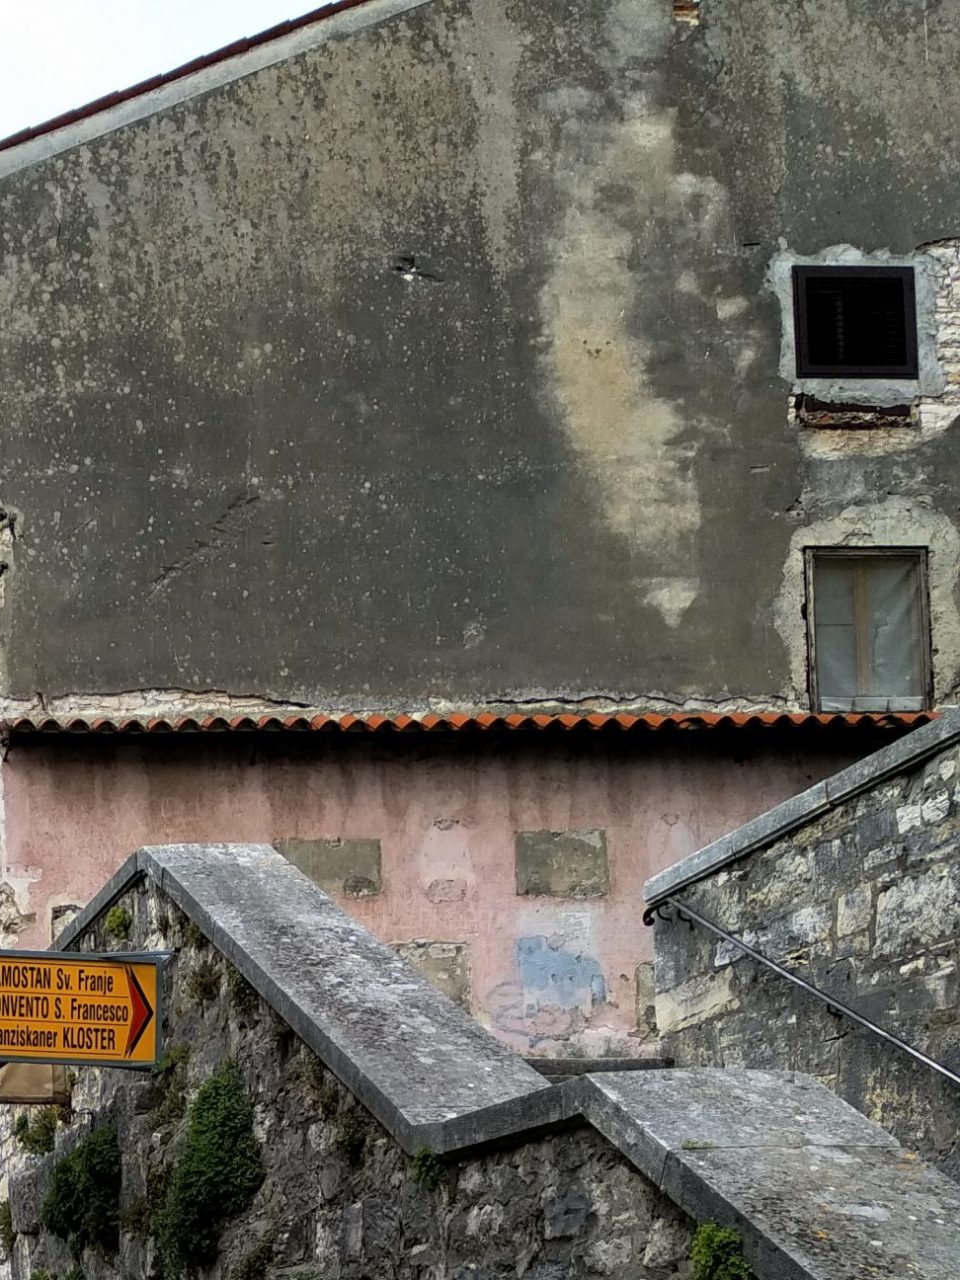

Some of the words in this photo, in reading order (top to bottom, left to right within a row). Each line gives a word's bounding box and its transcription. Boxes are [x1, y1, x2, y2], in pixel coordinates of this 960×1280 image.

[56, 968, 73, 991] Sv.
[78, 969, 113, 996] Franje
[54, 997, 65, 1019] S.
[70, 998, 128, 1022] Francesco
[63, 1026, 115, 1050] KLOSTER
